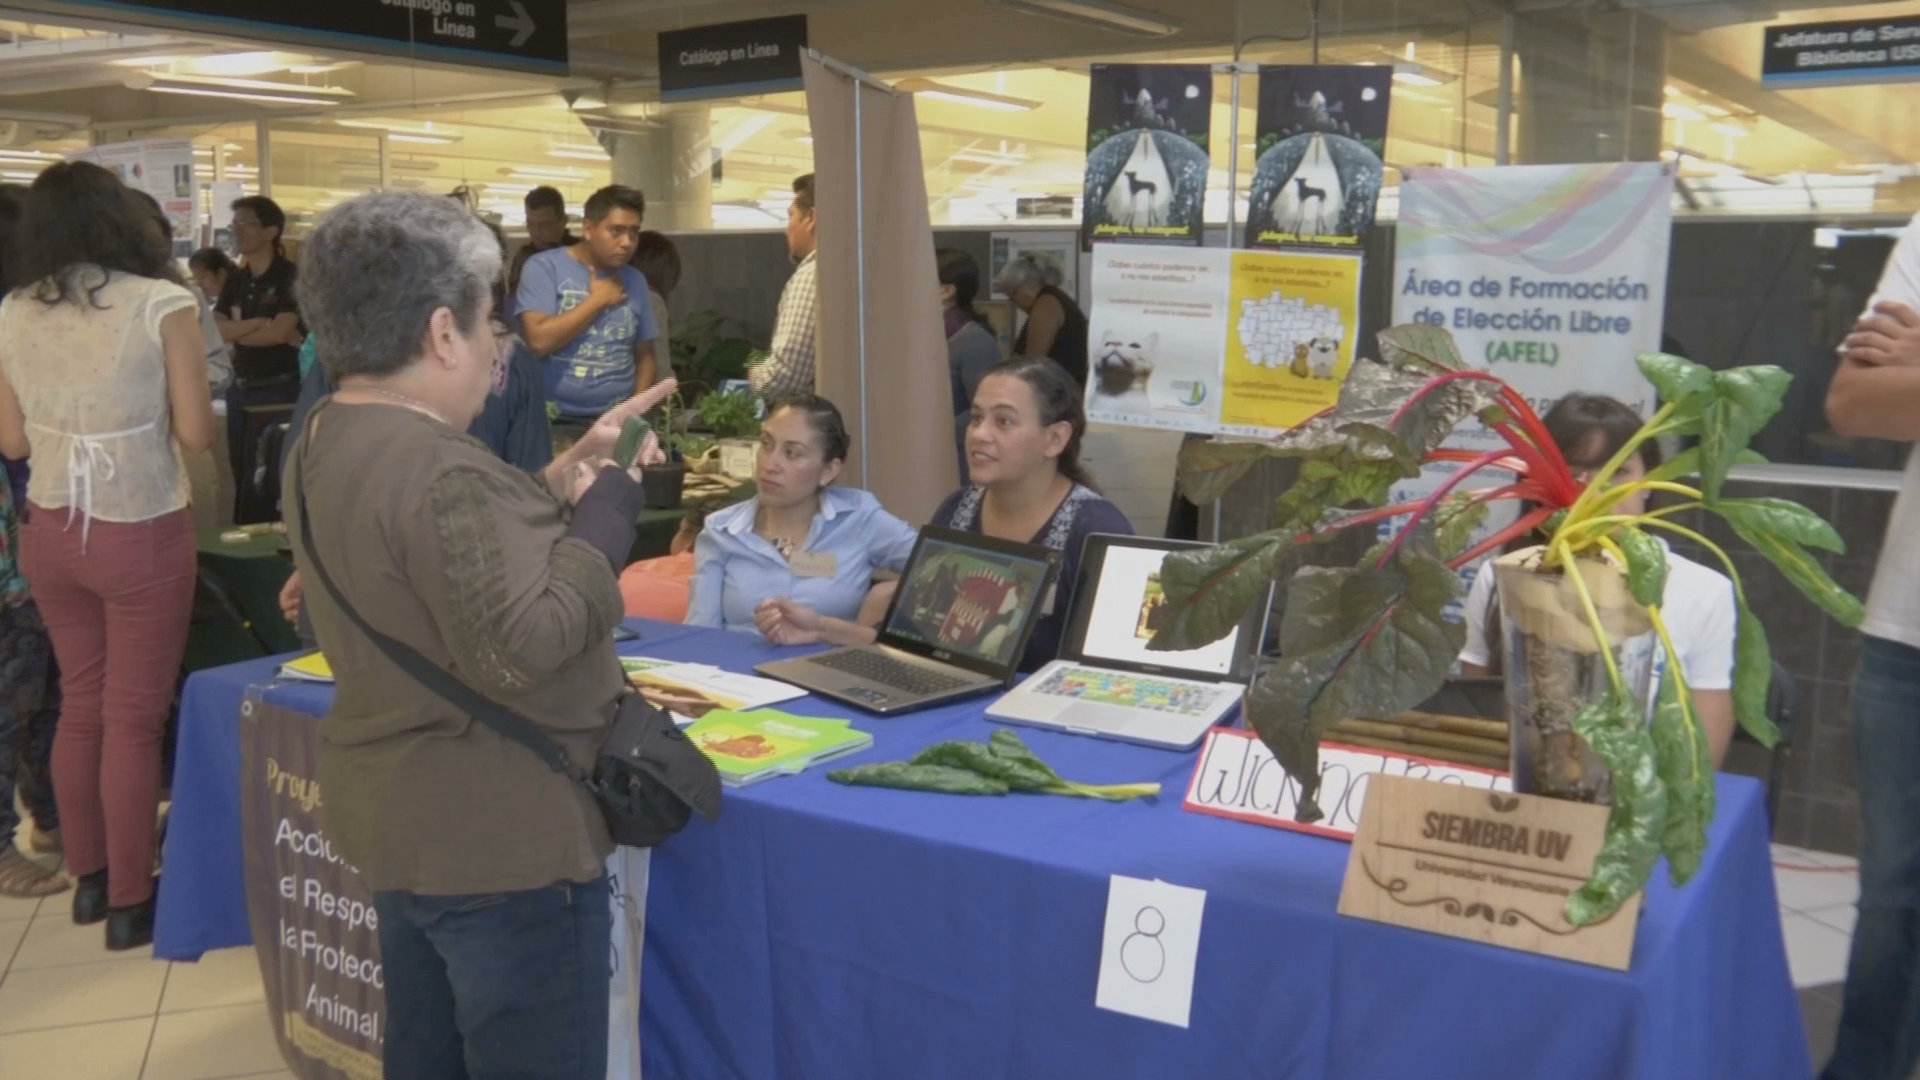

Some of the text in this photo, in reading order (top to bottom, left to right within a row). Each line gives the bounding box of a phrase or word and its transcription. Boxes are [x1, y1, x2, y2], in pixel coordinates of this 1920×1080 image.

[455, 2, 475, 18] en
[432, 16, 476, 39] Línea
[1773, 32, 1849, 48] Jefatura
[1850, 28, 1876, 43] de
[679, 43, 780, 67] Catálogo en Línea
[1796, 49, 1888, 67] Biblioteca
[1401, 268, 1649, 300] Área de Formación
[1413, 307, 1631, 335] de Elección Libre
[1485, 341, 1560, 366] (AFEL)
[1421, 811, 1573, 862] SIEMBRA UV
[1414, 858, 1488, 883] Universidad
[279, 873, 297, 901] el
[279, 918, 298, 950] la
[1120, 905, 1166, 984] 8
